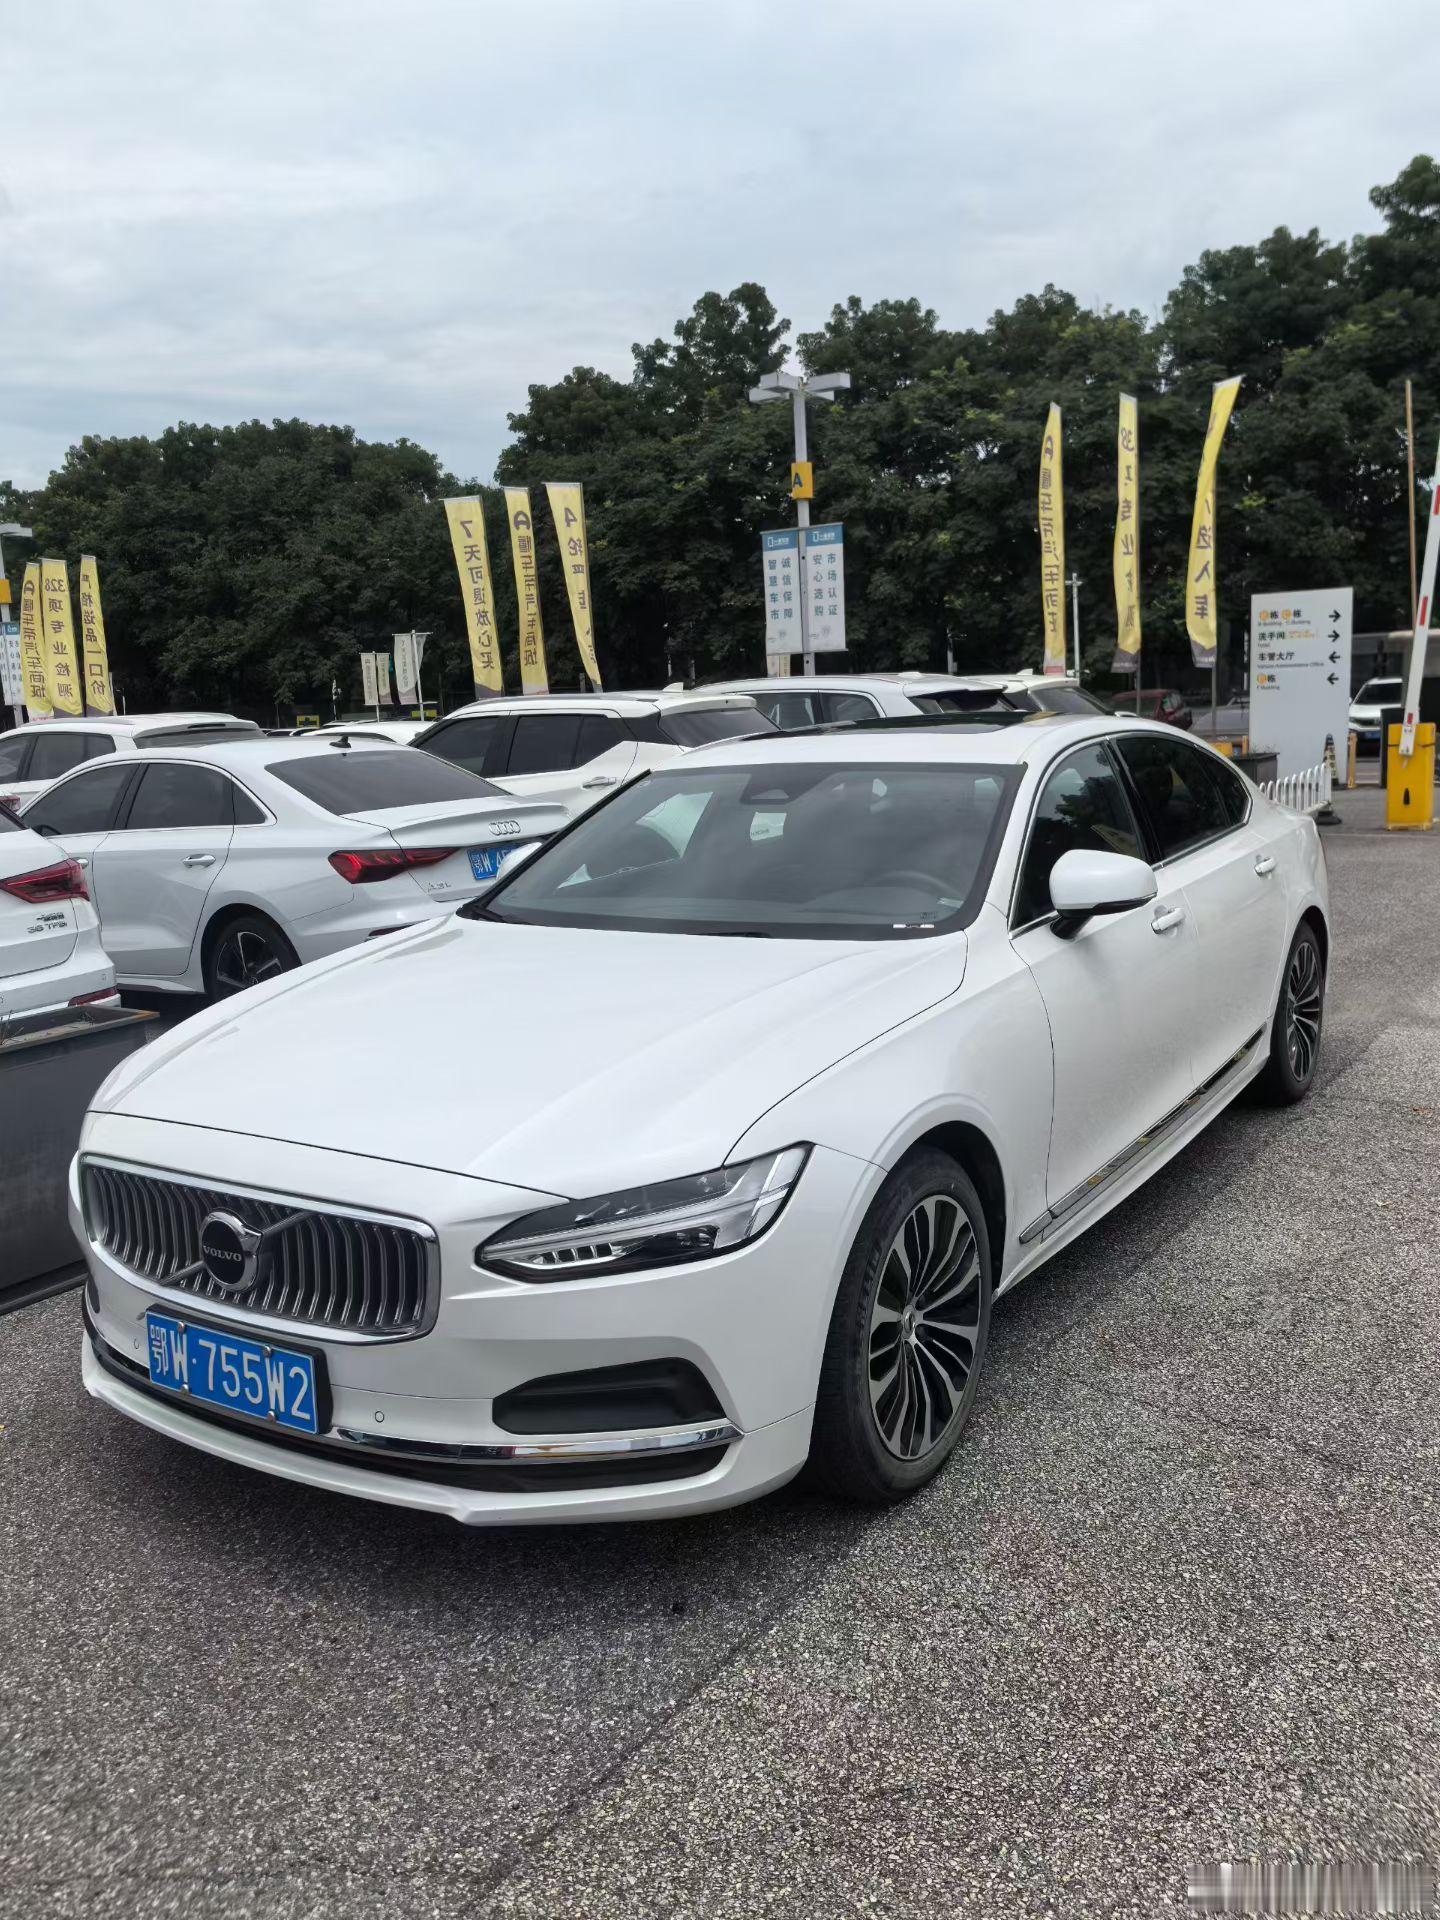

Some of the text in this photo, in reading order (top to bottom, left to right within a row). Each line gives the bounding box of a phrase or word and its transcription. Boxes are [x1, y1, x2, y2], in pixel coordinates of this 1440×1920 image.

[793, 472, 803, 488] A
[768, 559, 779, 620] 智慧车市
[781, 556, 793, 619] 诚信保障
[813, 554, 824, 616] 安心选购
[827, 553, 838, 616] 市场认证
[203, 1245, 242, 1262] VOLVO
